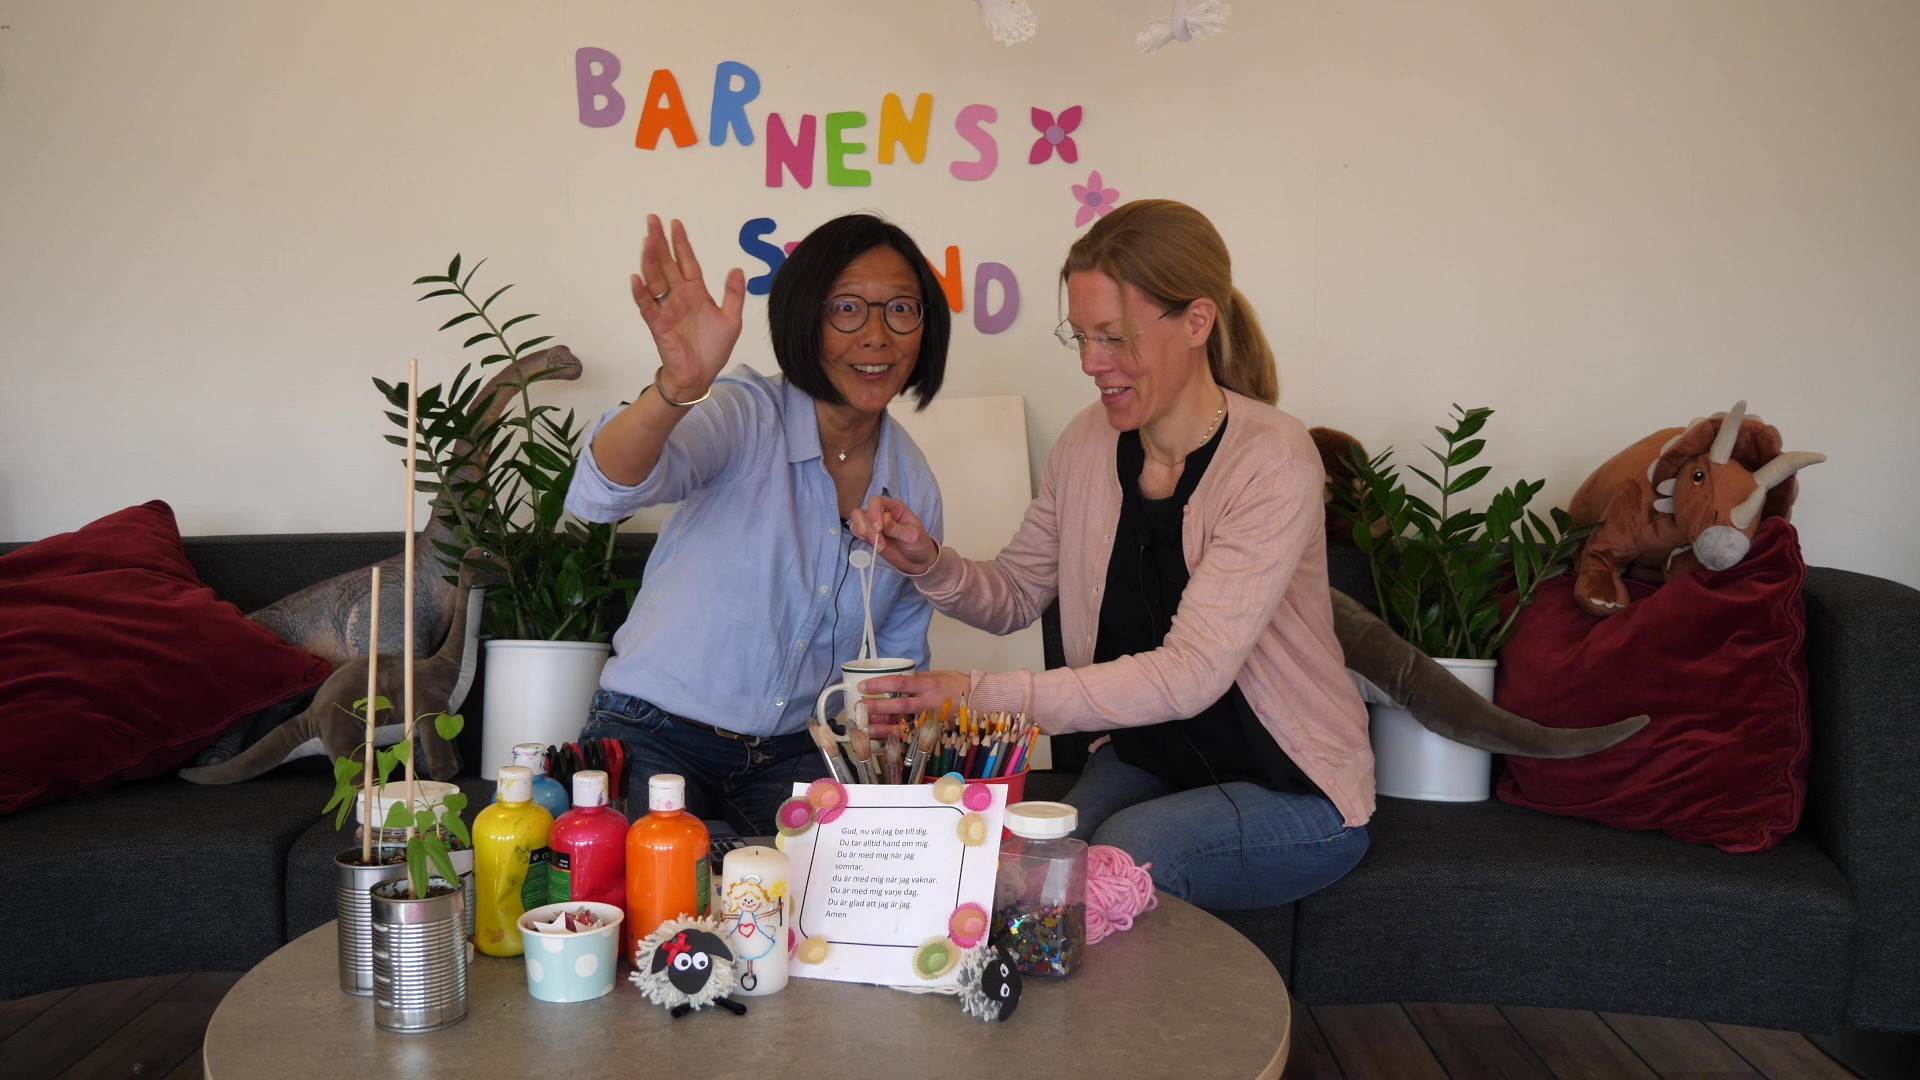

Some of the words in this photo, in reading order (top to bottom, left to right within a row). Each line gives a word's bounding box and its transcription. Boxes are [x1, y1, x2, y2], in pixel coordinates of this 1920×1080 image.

[739, 217, 1020, 335] SND
[916, 828, 928, 836] dig.
[885, 889, 902, 897] varje
[904, 888, 918, 897] dag.
[878, 901, 888, 909] jag
[899, 901, 912, 909] jag.
